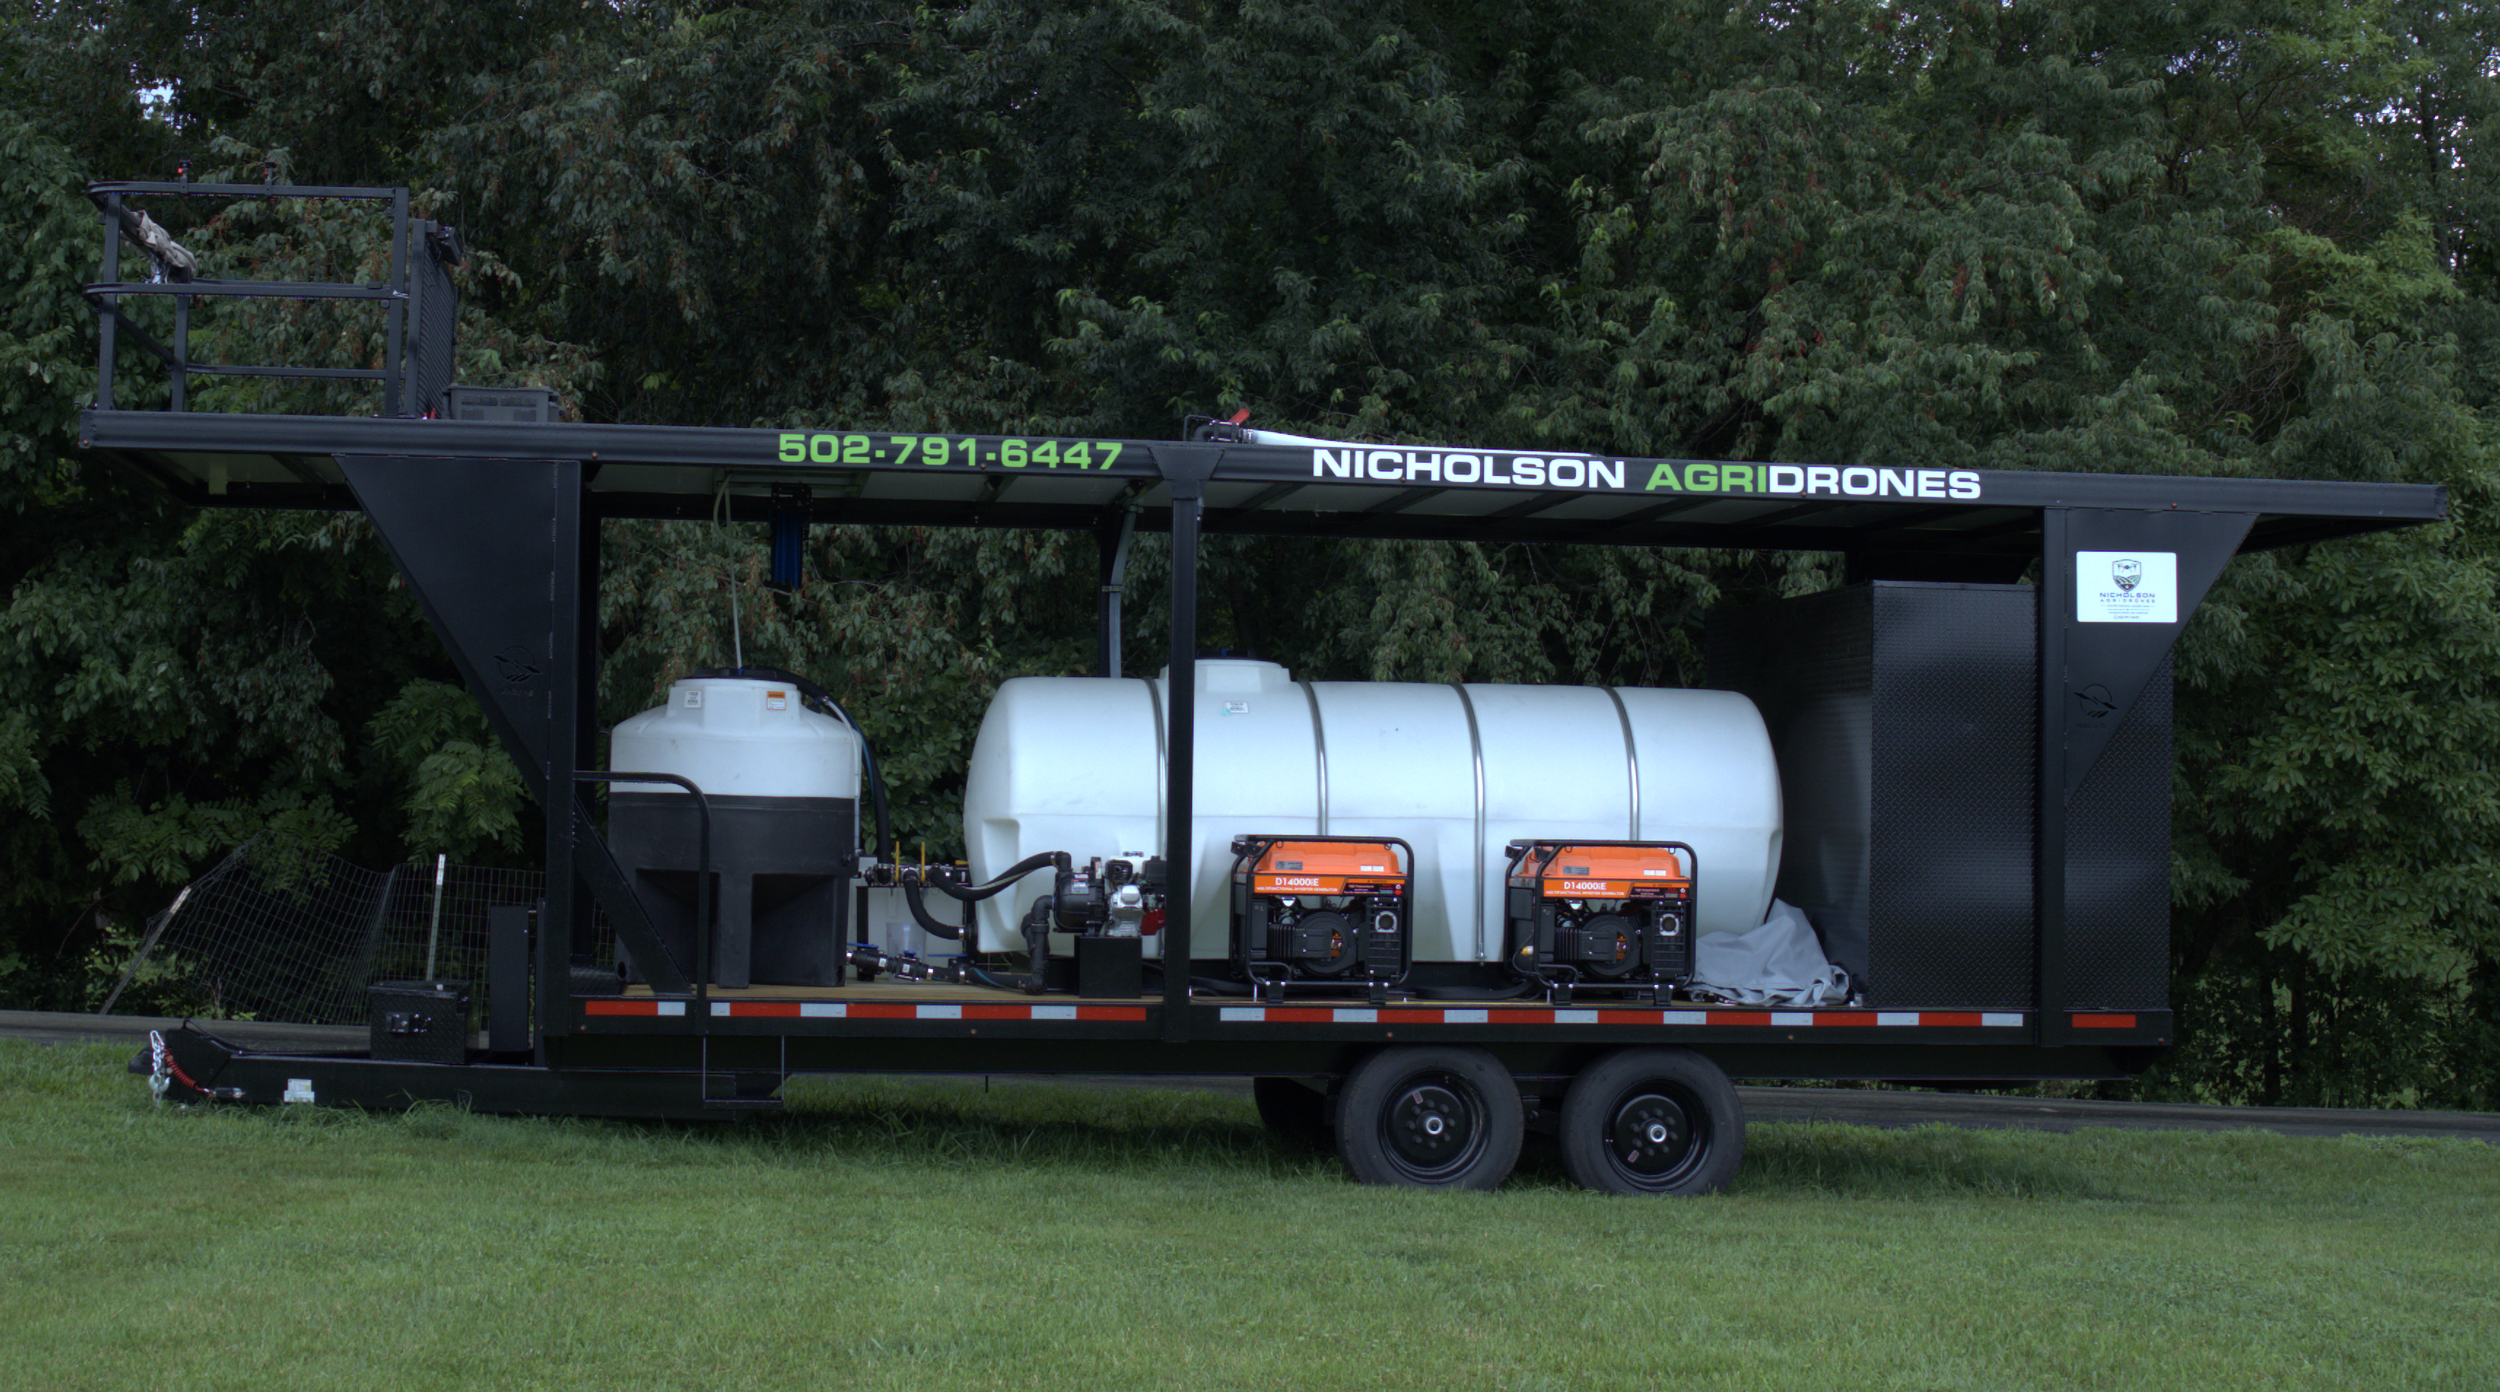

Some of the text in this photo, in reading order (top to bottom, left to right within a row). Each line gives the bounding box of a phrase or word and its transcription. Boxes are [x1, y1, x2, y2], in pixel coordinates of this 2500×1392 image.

[779, 433, 1123, 470] 502-791-6447
[1313, 448, 1981, 500] NICHOLSON AGRIDRONES
